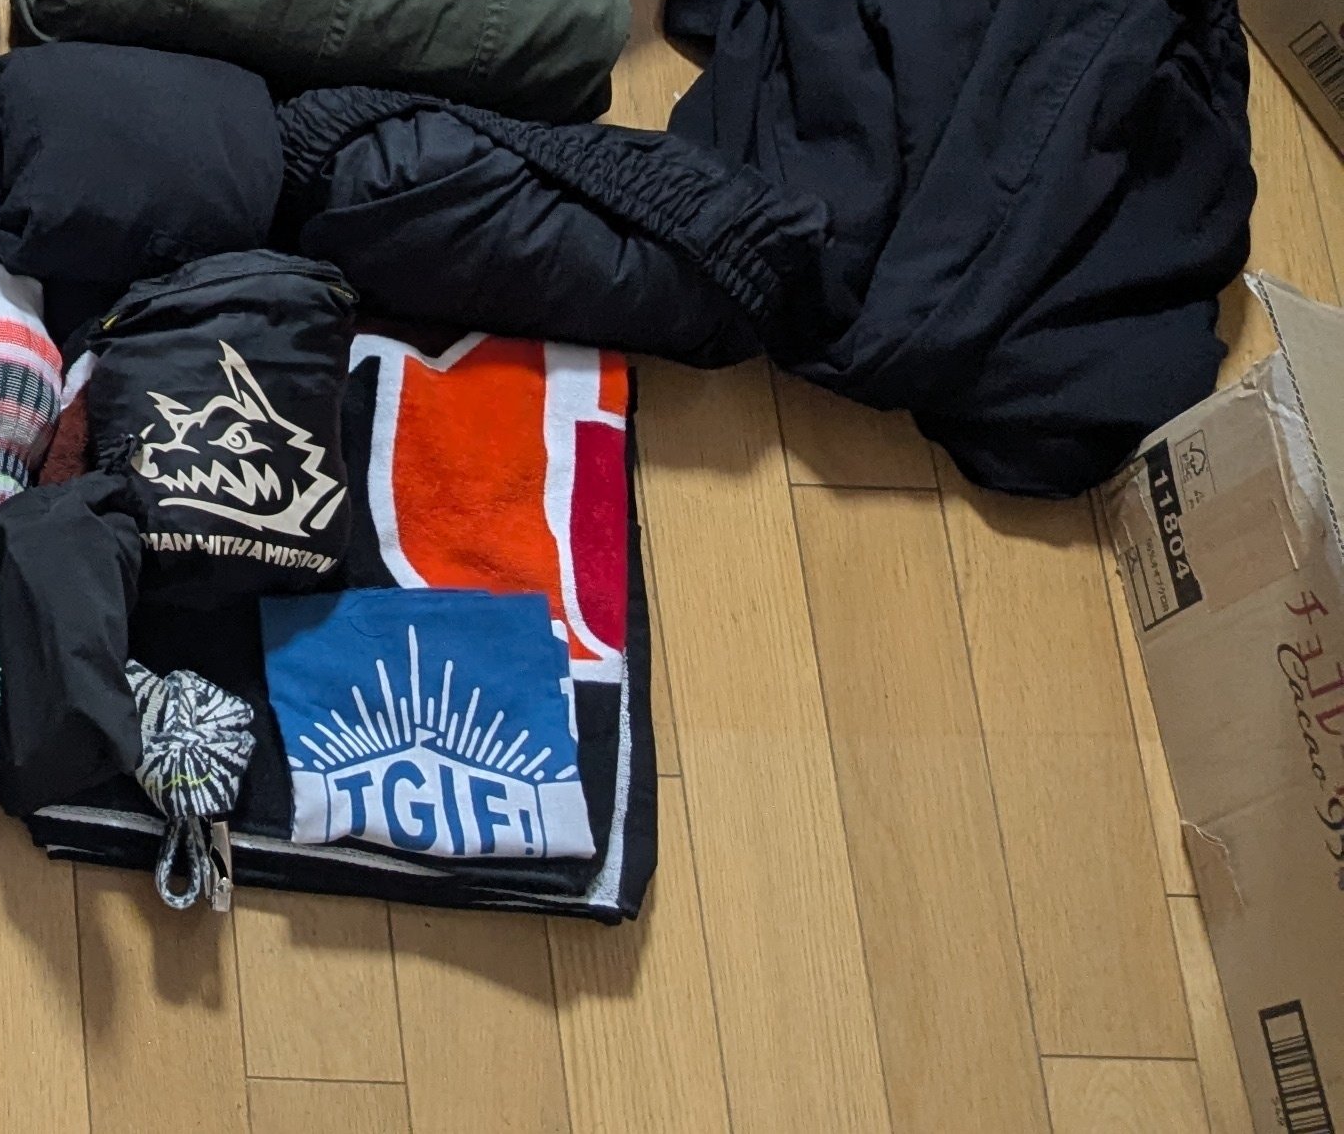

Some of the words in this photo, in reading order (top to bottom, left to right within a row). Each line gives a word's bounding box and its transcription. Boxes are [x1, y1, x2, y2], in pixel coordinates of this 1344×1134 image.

[140, 532, 193, 552] MAN
[265, 542, 338, 574] MISSION
[1154, 469, 1190, 580] 11804
[1277, 644, 1326, 792] Cacao
[335, 769, 533, 856] TGIF!
